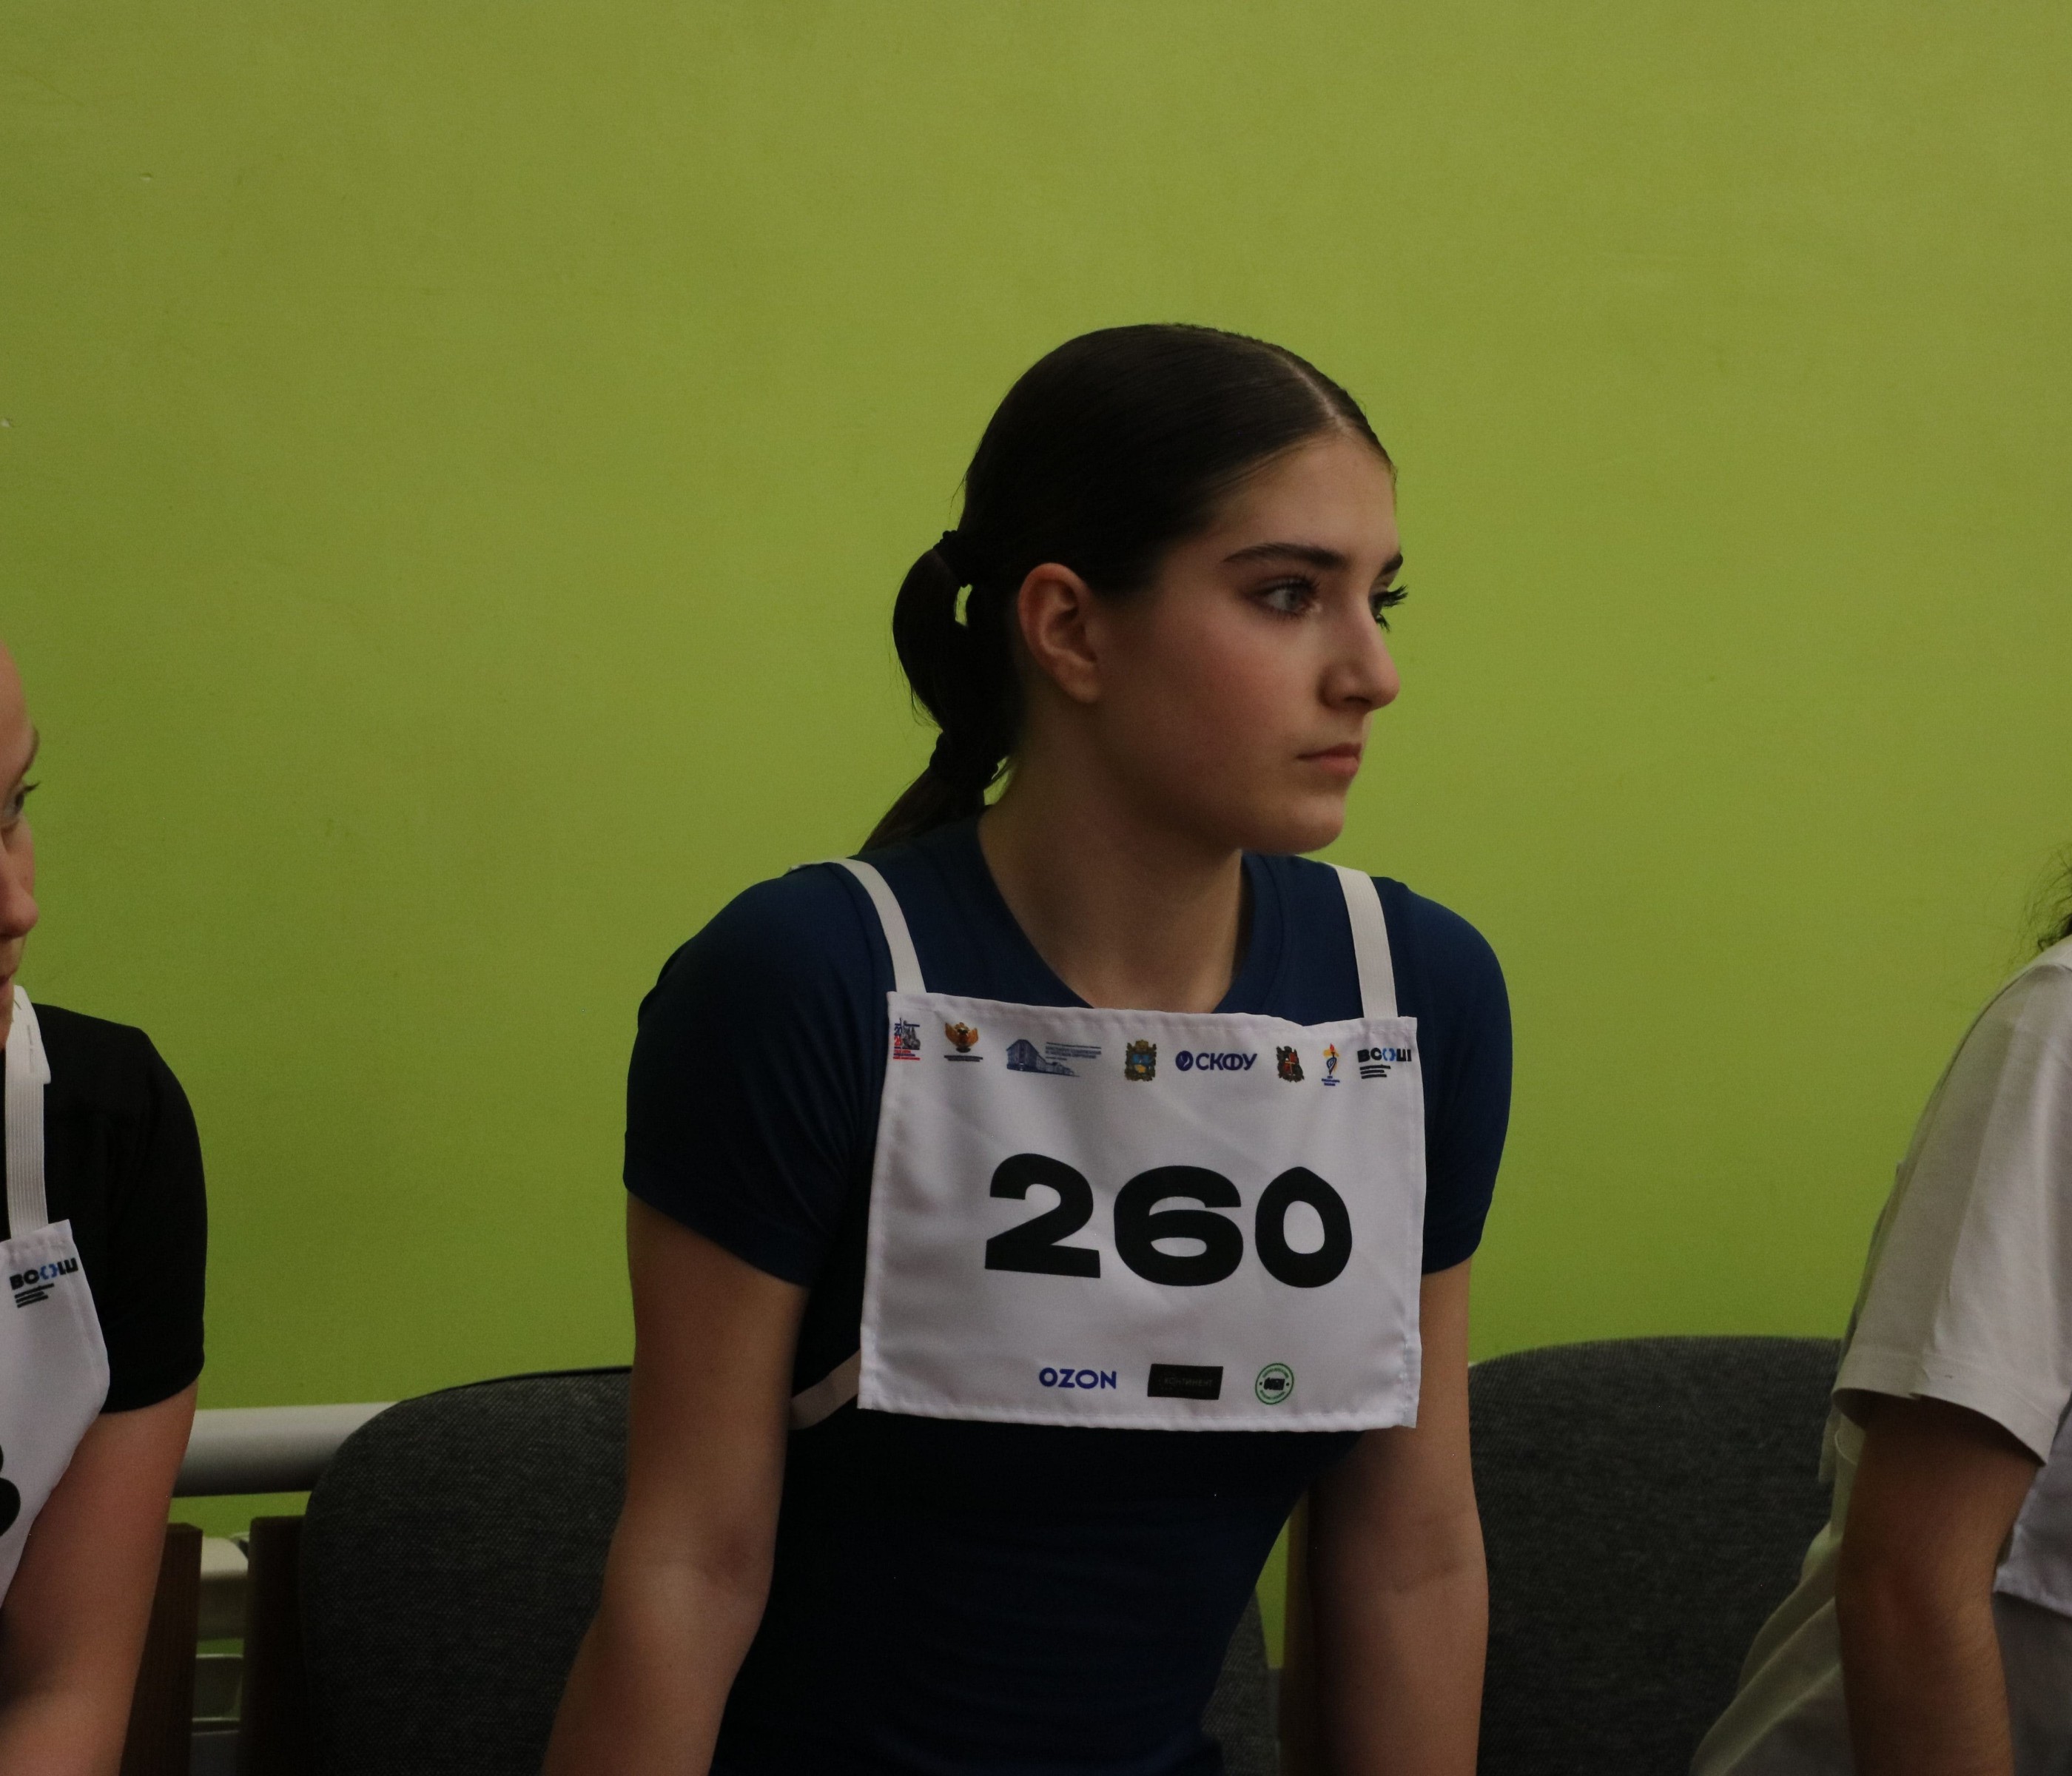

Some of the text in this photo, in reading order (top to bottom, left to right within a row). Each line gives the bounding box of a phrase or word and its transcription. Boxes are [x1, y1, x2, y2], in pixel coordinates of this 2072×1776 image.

[1195, 1052, 1258, 1071] СКФУ
[985, 1153, 1352, 1288] 260
[1039, 1368, 1117, 1389] OZON
